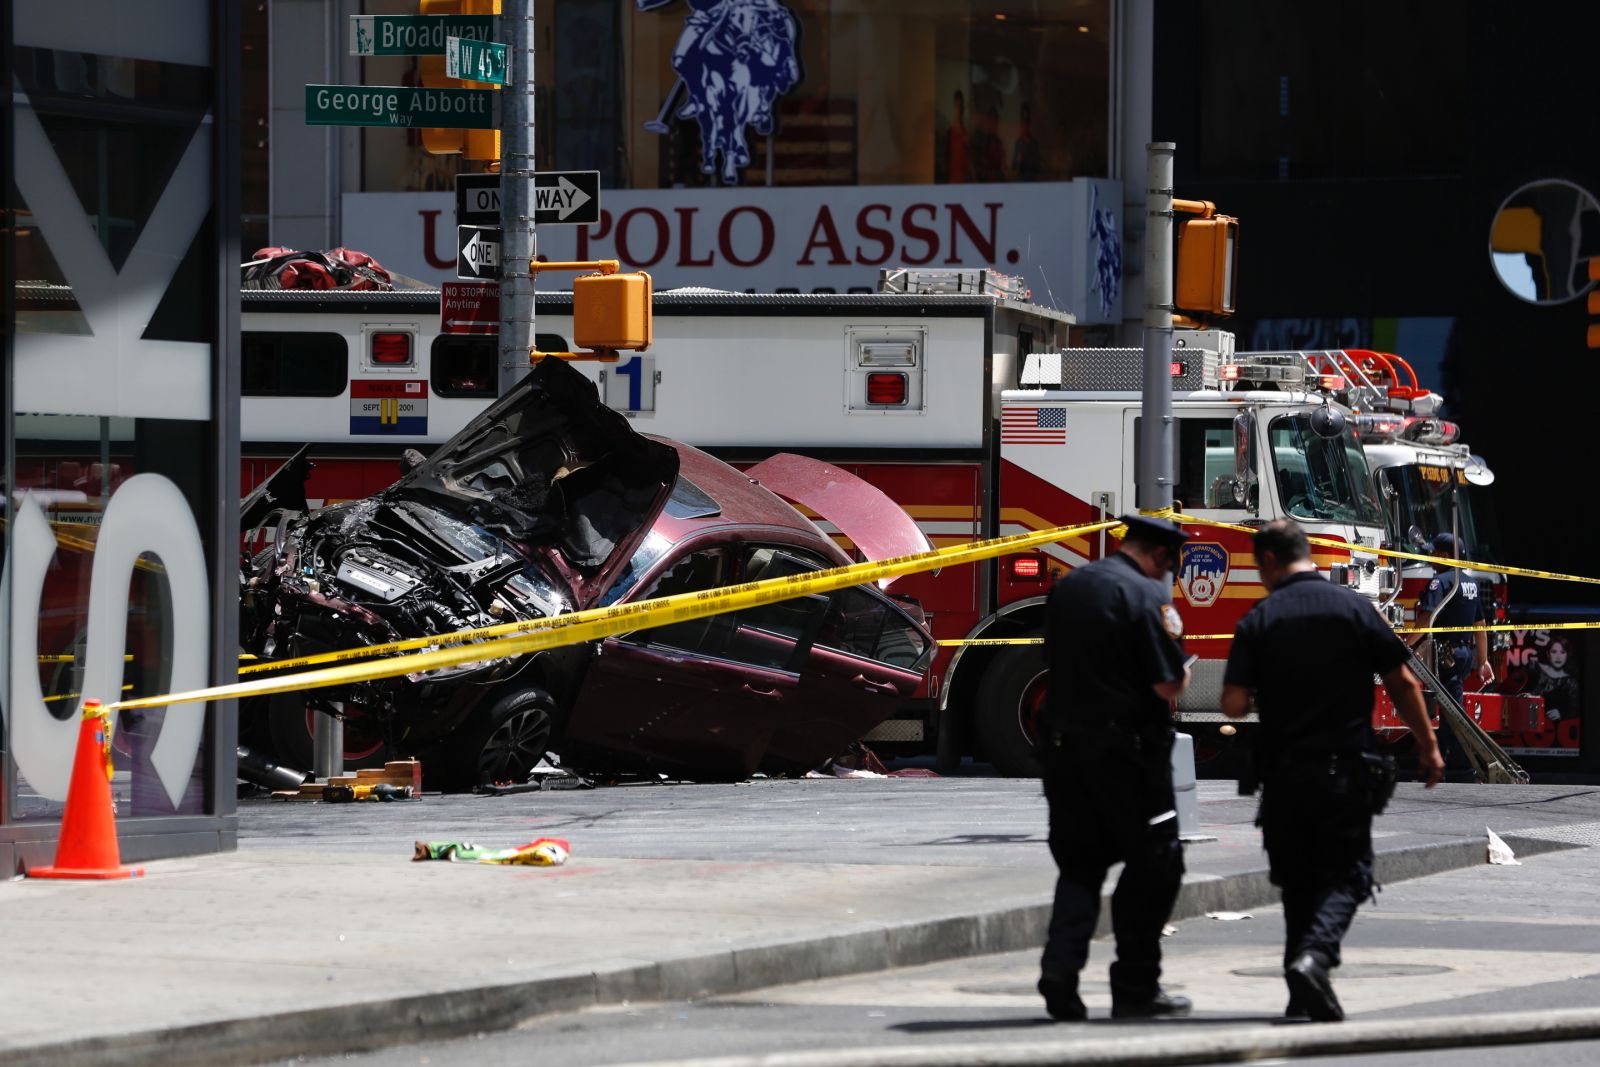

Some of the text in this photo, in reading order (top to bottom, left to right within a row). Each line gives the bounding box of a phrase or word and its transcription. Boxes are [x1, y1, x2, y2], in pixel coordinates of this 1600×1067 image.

[382, 18, 489, 48] Broadway
[462, 45, 473, 75] W
[478, 47, 492, 78] 45
[316, 89, 485, 116] George Abbott
[389, 113, 413, 126] Way
[477, 189, 577, 210] ON WAY
[575, 205, 775, 269] POLO
[796, 203, 1020, 266] ASSN.
[470, 243, 492, 263] ONE
[445, 287, 500, 298] NO STOPPING
[445, 299, 480, 311] Anytime
[616, 356, 641, 411] 1
[399, 403, 414, 411] 2001
[697, 591, 709, 600] FIRE
[710, 590, 721, 598] LINE
[731, 586, 740, 594] NOT
[742, 582, 760, 592] CROSS
[1461, 582, 1478, 594] NYPD
[607, 608, 619, 617] FIRE
[620, 606, 631, 616] LINE
[641, 602, 651, 611] NOT
[652, 600, 670, 609] CROSS
[517, 623, 529, 631] FIRE
[530, 621, 541, 629] LINE
[551, 618, 561, 626] NOT
[563, 615, 580, 623] CROSS
